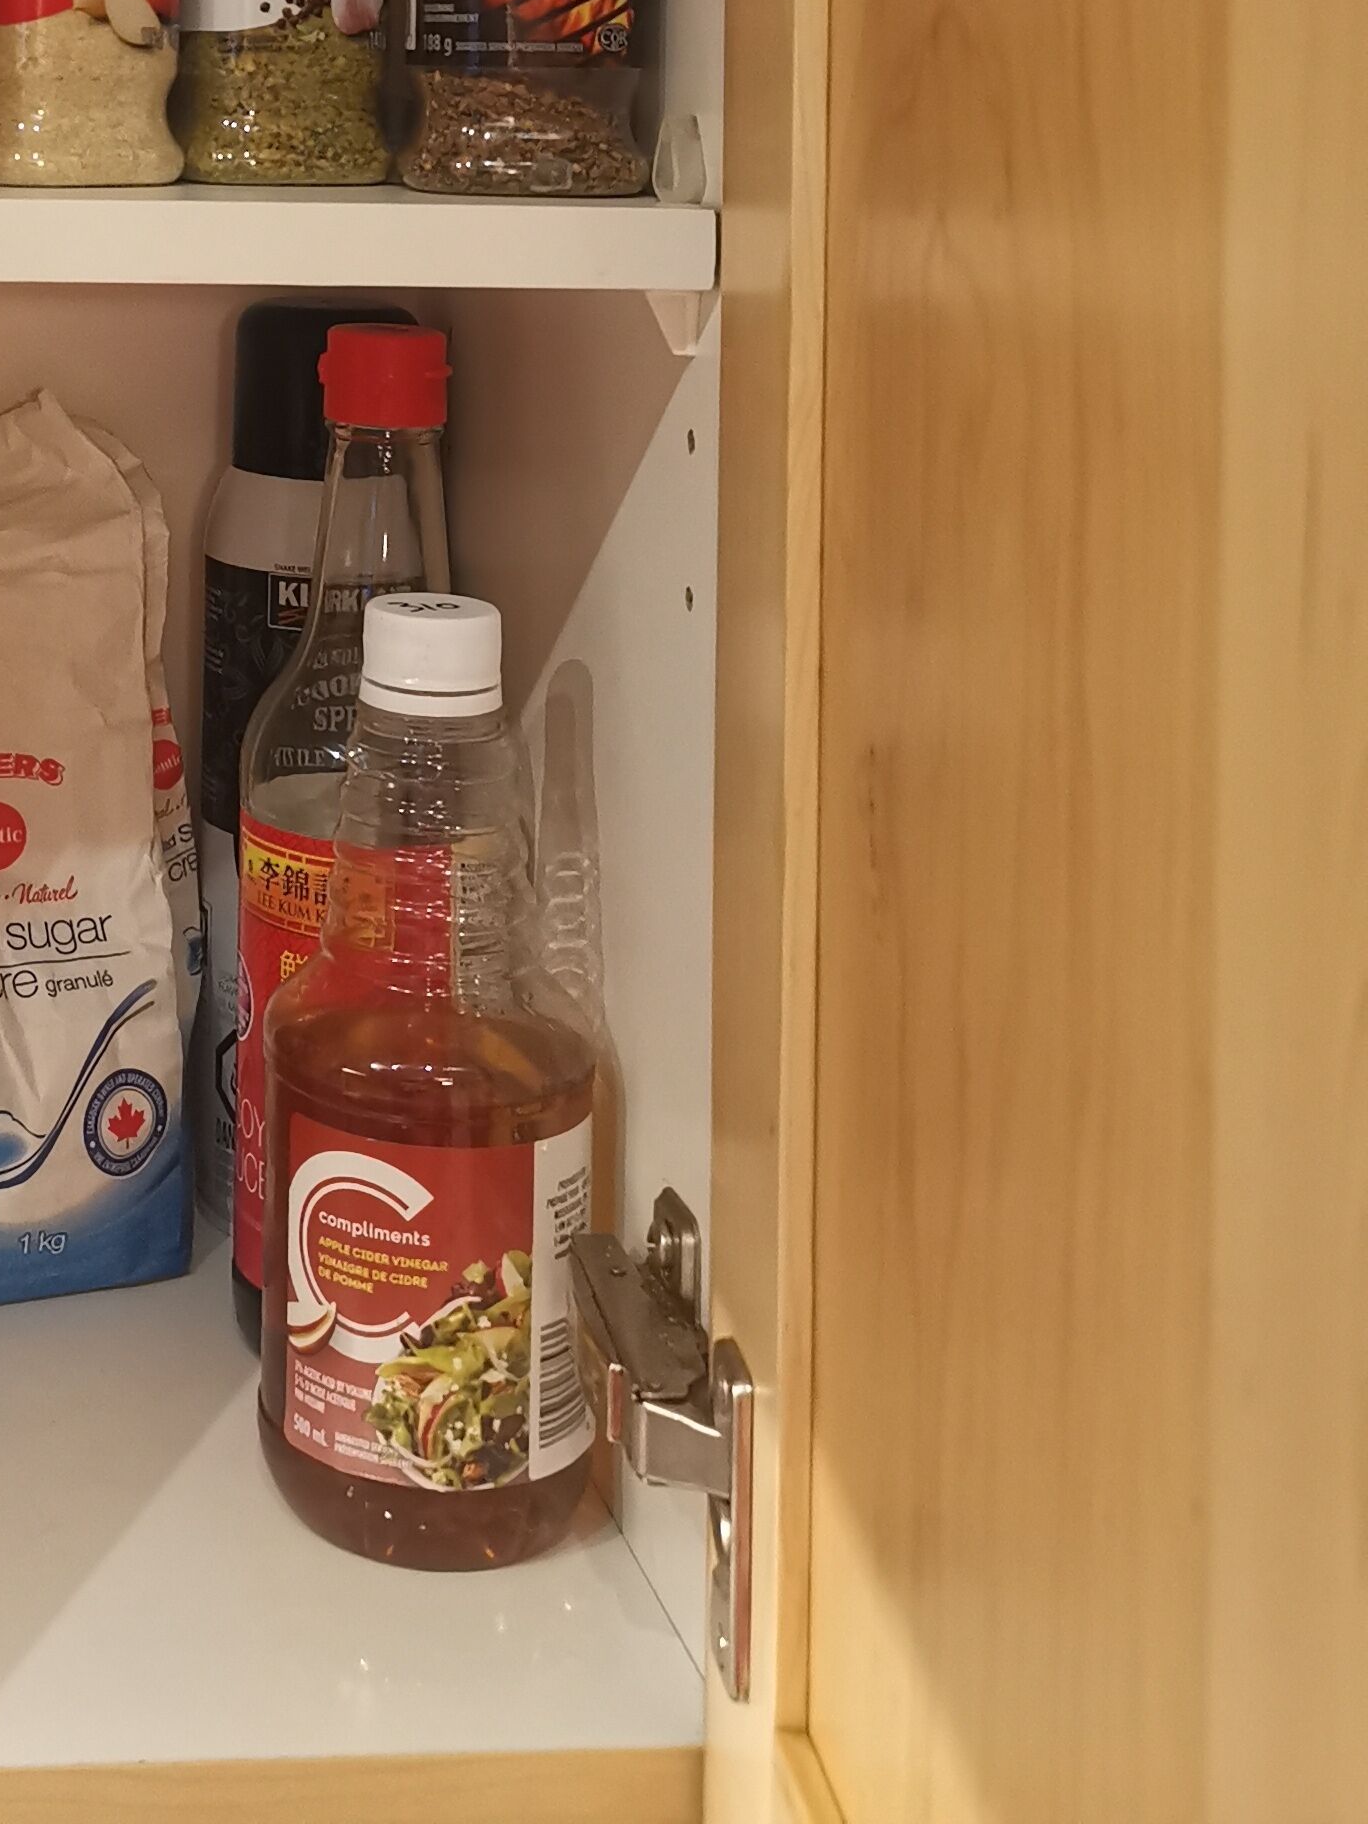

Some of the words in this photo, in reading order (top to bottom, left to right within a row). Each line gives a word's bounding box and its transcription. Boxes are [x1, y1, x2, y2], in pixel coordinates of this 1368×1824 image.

[444, 38, 452, 56] g
[12, 876, 78, 905] Naturel
[258, 891, 276, 909] LEE
[278, 899, 311, 921] KUM
[5, 914, 112, 954] sugar
[45, 970, 114, 997] granulé
[239, 1096, 265, 1148] OY
[19, 1234, 29, 1255] 1
[38, 1231, 67, 1255] kg
[319, 1210, 431, 1246] compliments
[318, 1236, 351, 1256] APPLE
[352, 1247, 391, 1265] CIDER
[392, 1256, 449, 1272] VINEGAR
[318, 1252, 370, 1278] VINAIGRE
[372, 1269, 387, 1282] DE
[389, 1272, 428, 1288] CIDRE
[318, 1265, 331, 1279] DE
[333, 1271, 374, 1293] POMME
